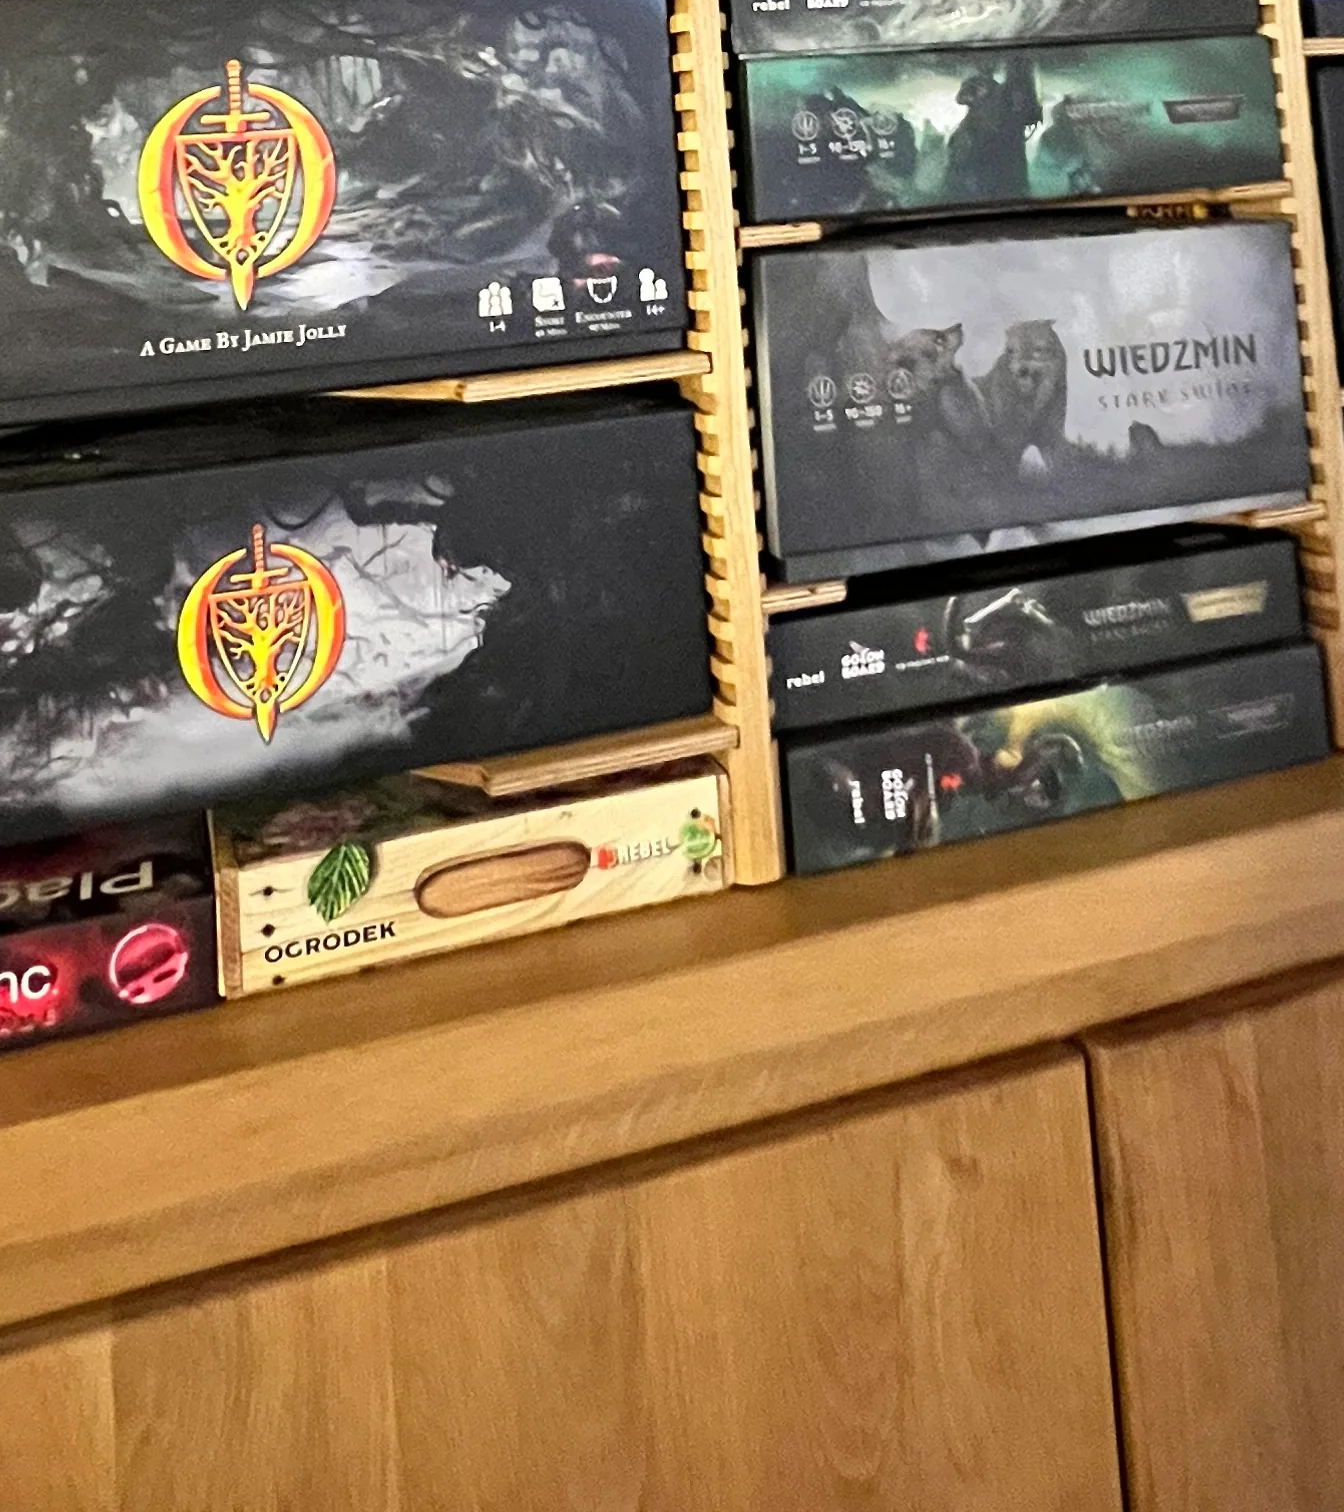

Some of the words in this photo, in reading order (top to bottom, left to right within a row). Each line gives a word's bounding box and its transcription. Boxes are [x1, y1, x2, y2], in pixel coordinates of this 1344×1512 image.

[139, 340, 156, 357] A
[159, 337, 212, 354] GAME
[241, 329, 294, 352] JAMIE
[296, 324, 347, 347] JOLLY
